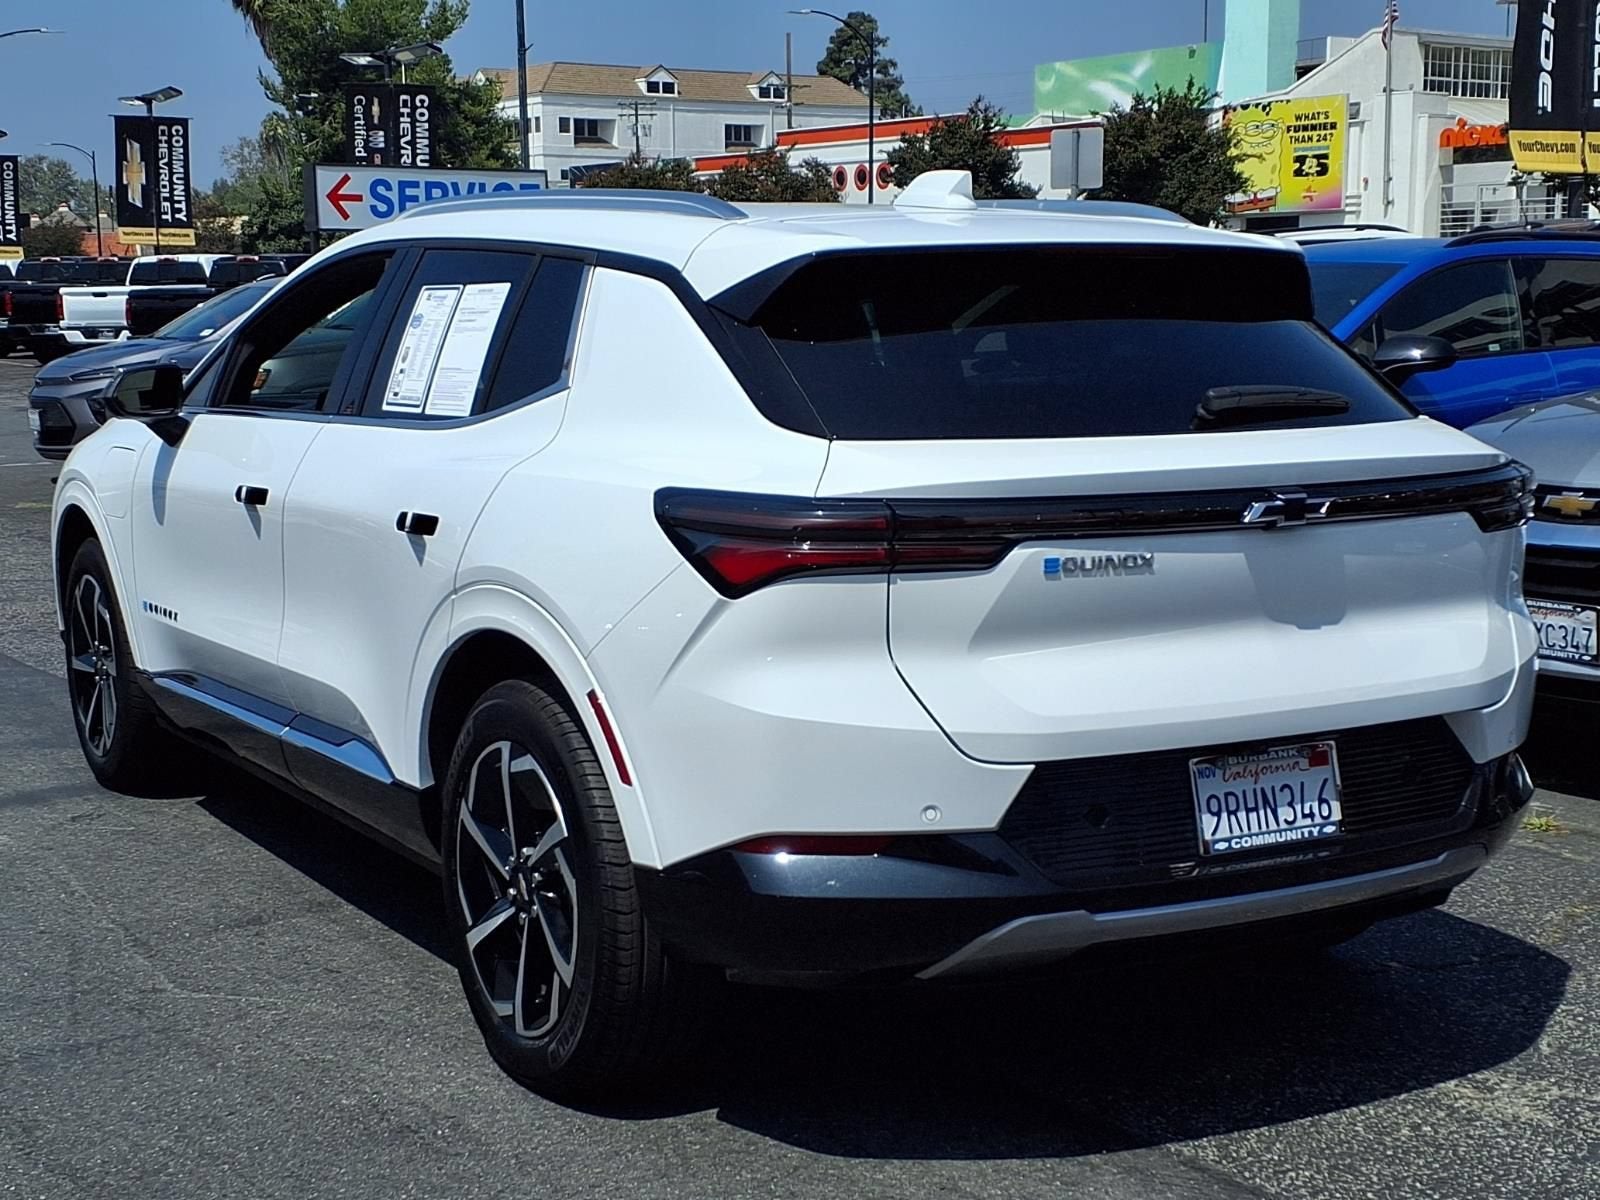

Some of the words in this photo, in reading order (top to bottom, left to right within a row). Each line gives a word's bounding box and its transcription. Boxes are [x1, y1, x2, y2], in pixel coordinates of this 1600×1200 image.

[354, 95, 368, 157] Certified
[1286, 122, 1338, 134] FUNNIER
[1294, 110, 1330, 122] WHAT'S
[1289, 134, 1314, 145] THAN
[1316, 132, 1334, 143] 24?
[1517, 140, 1577, 153] YourChevy.com
[158, 125, 172, 222] CHEVROLET
[171, 125, 188, 222] COMMUNITY
[1293, 152, 1330, 177] 25
[3, 161, 17, 241] COMMUNITY
[1044, 553, 1155, 574] EQUINOX
[1228, 748, 1299, 765] BURBANK
[1197, 766, 1217, 780] NOV
[1221, 760, 1310, 785] California
[1205, 777, 1333, 837] 9RHN346
[1230, 825, 1321, 849] COMMUNITY
